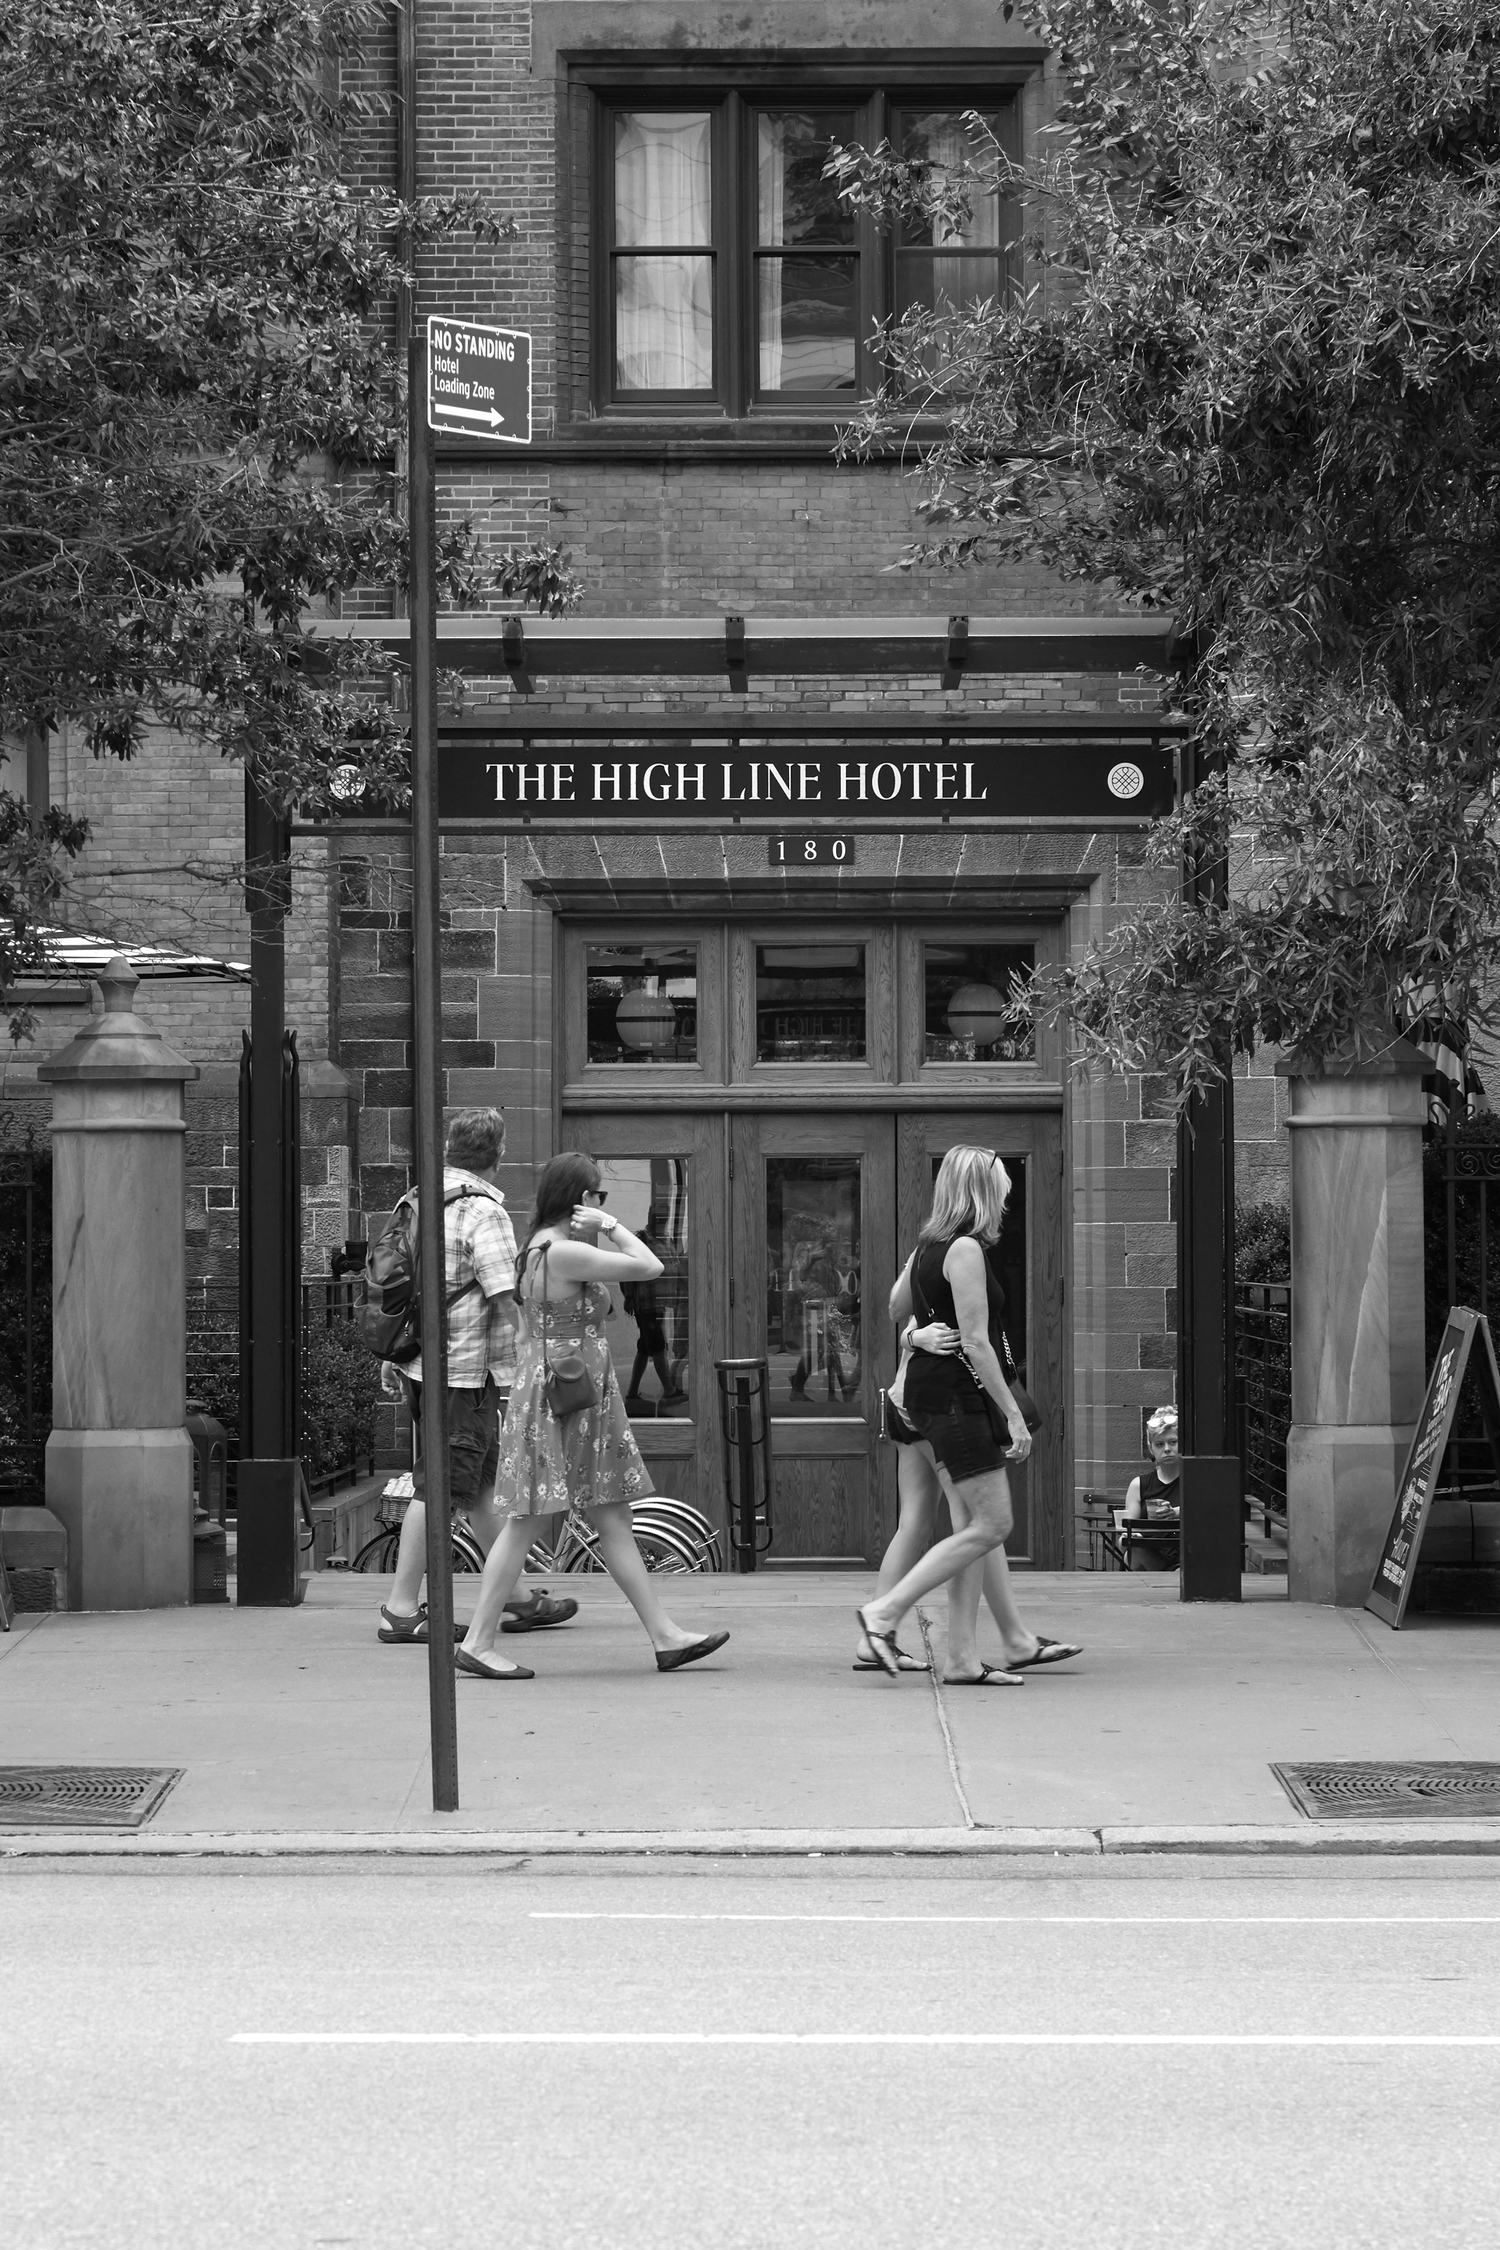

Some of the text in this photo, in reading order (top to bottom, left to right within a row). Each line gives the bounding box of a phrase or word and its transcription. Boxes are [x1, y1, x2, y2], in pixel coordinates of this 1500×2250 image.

[435, 329, 515, 362] NO STANDING
[435, 355, 459, 374] Hotel
[435, 375, 495, 400] Loading Zone
[486, 762, 988, 800] THE HIGH LINE HOTEL
